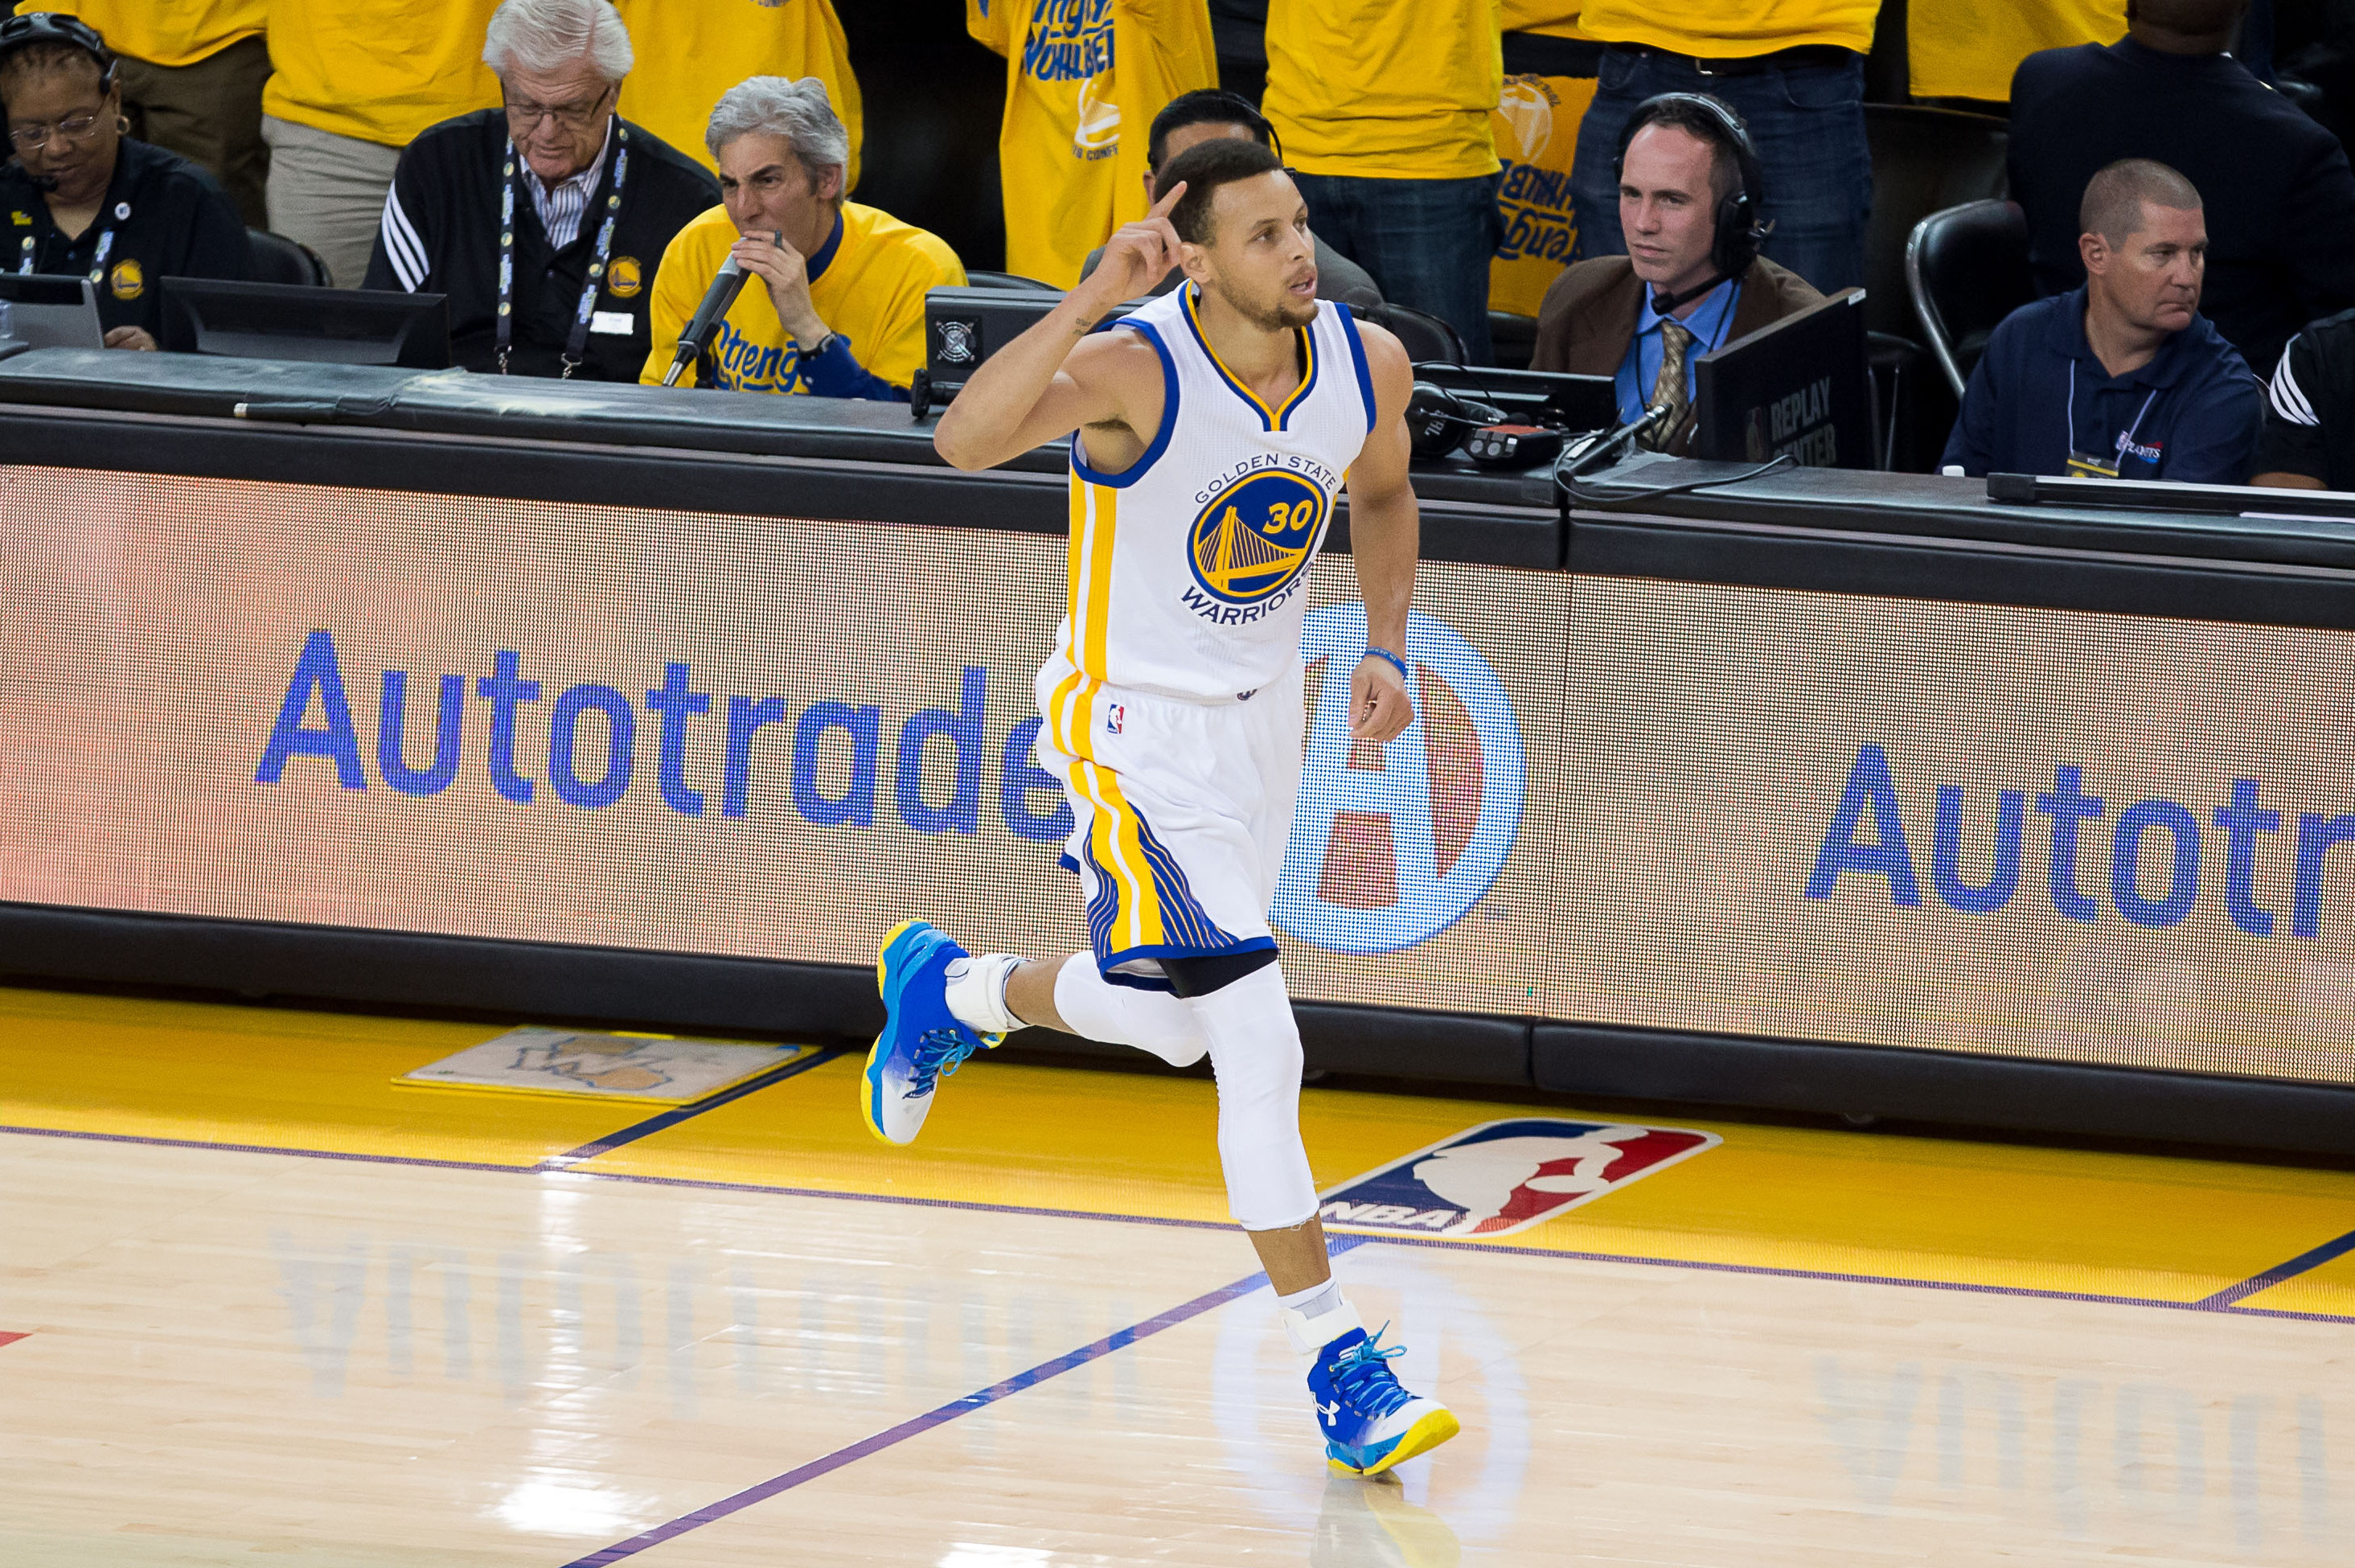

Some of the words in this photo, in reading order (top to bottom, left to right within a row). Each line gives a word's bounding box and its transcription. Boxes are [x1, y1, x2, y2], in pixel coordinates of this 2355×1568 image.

[1770, 375, 1831, 442] REPLAY
[1195, 454, 1279, 504] GOLDEN
[1288, 456, 1336, 491] STATE
[1262, 499, 1314, 534] 30
[1181, 560, 1315, 626] WARRIORS
[256, 629, 1076, 843] Autotrade
[1319, 1201, 1458, 1229] NBA
